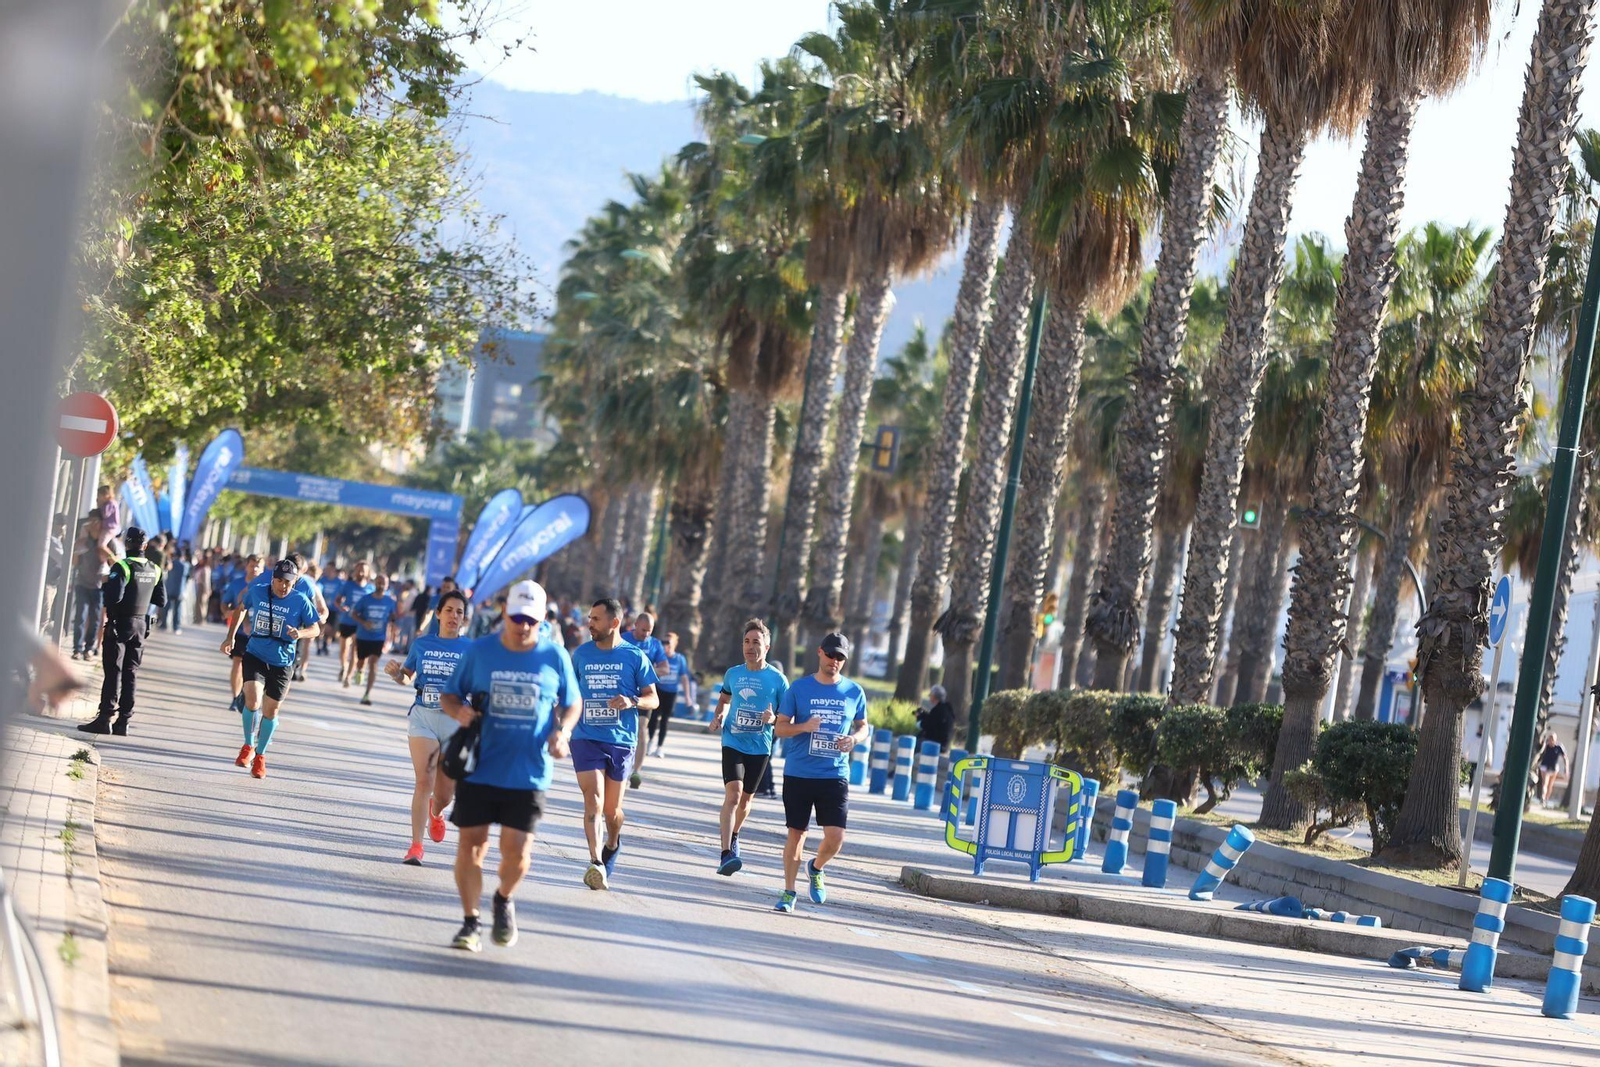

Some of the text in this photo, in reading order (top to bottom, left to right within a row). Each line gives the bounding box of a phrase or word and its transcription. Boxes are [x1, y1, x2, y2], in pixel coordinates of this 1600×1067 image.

[189, 446, 233, 517] mayoral
[391, 491, 453, 512] mayoral
[501, 511, 573, 572] mayoral
[259, 601, 290, 614] mayoral
[257, 621, 280, 632] 183
[585, 663, 623, 672] mayoral
[810, 698, 847, 707] mayoral
[588, 708, 616, 717] 1543
[739, 717, 762, 726] 1779
[814, 740, 840, 751] 1580
[1001, 850, 1014, 858] LOCAL
